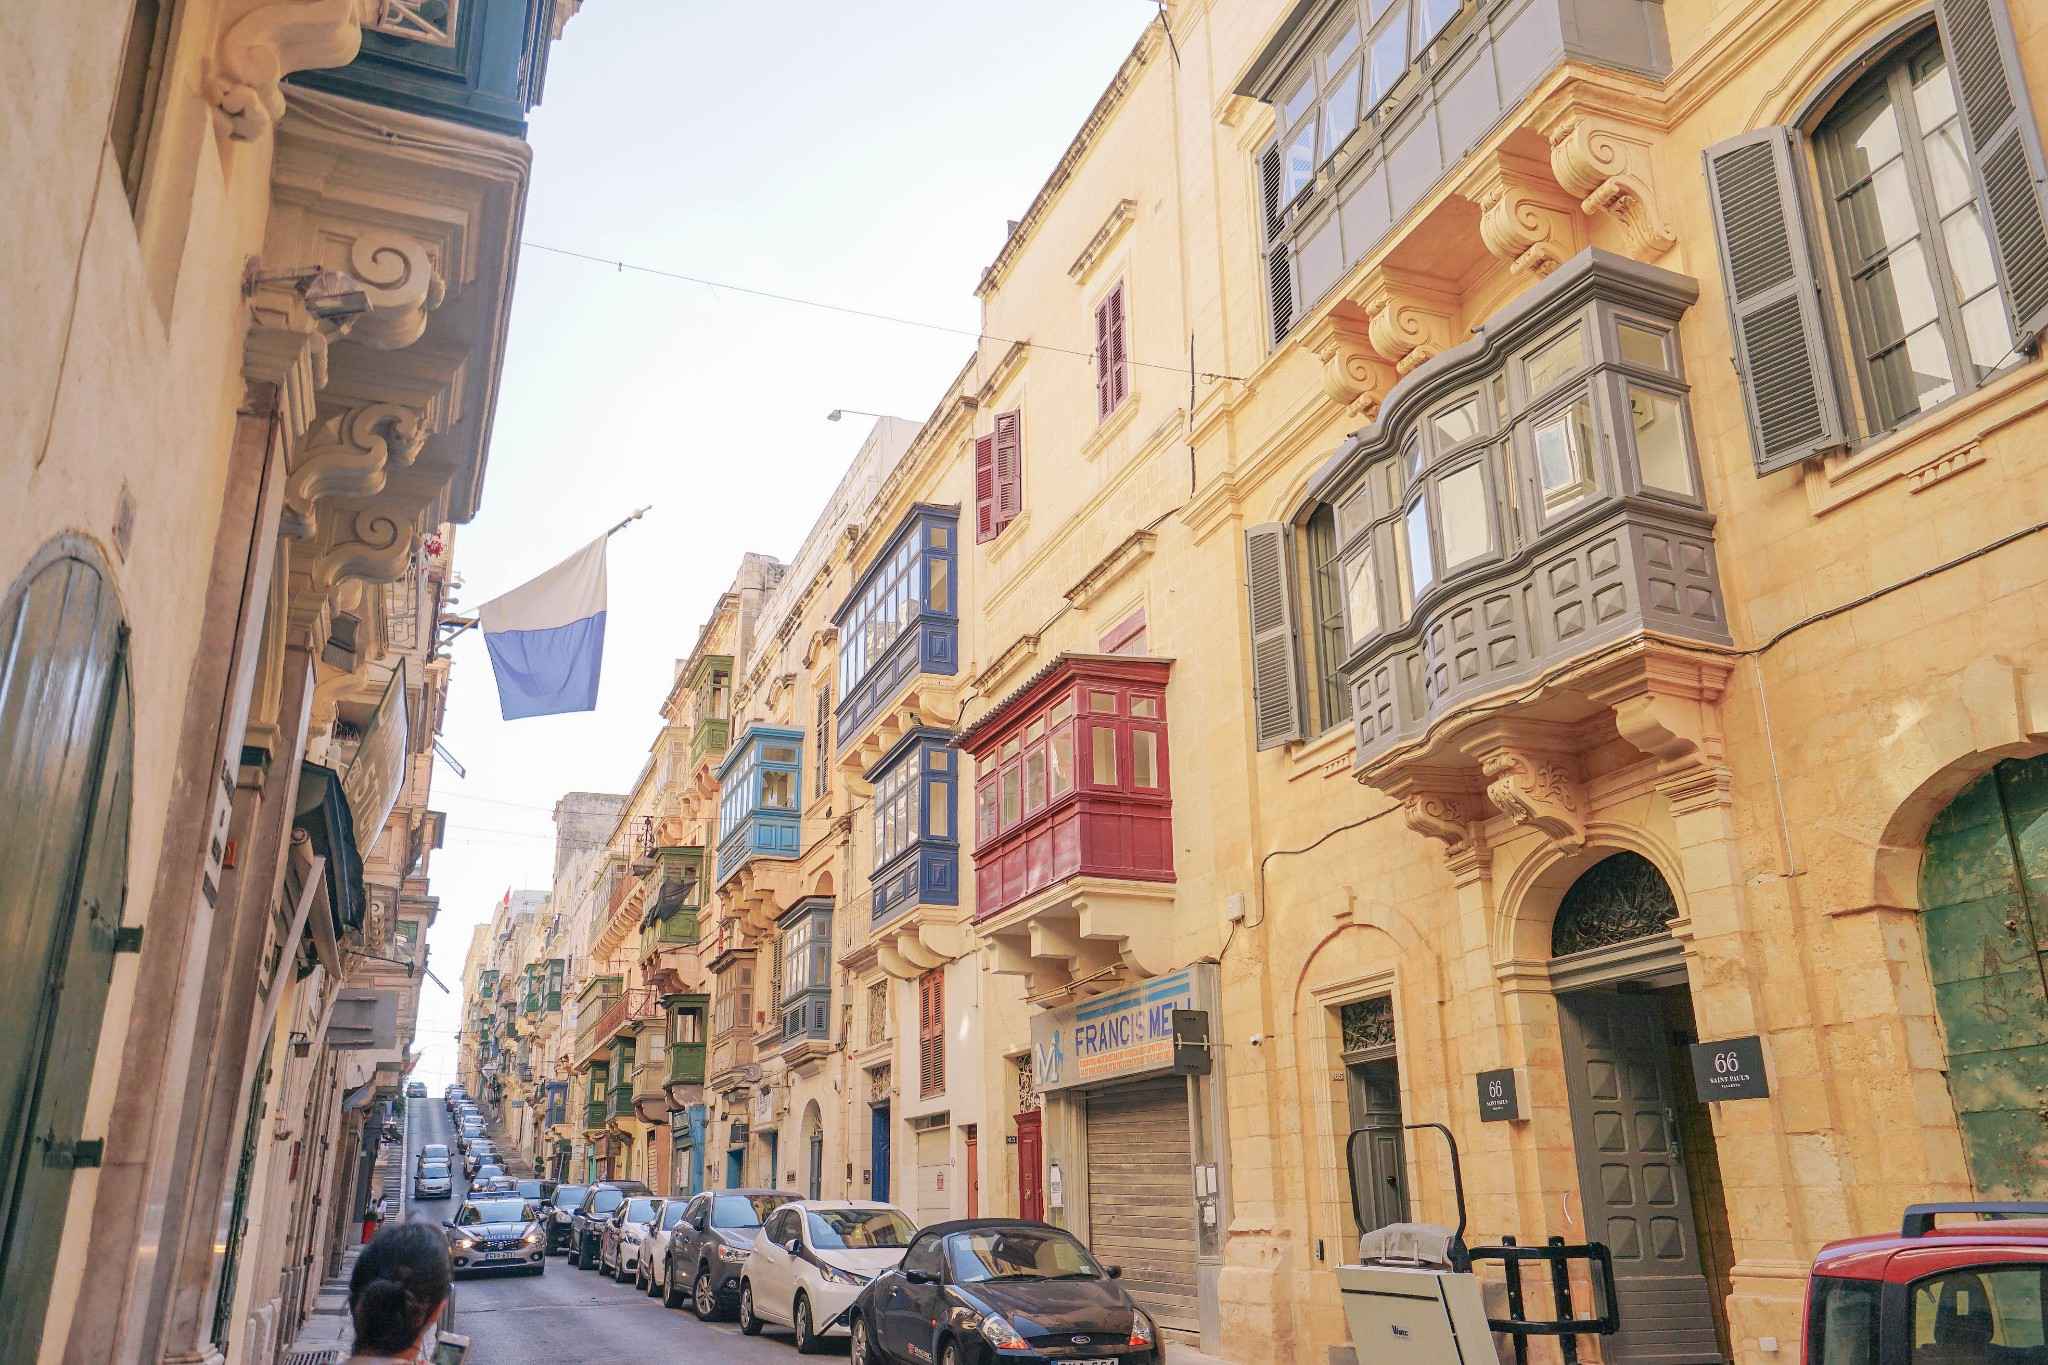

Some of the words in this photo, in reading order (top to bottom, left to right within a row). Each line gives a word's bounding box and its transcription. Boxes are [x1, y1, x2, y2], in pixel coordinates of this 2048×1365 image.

[1075, 1014, 1144, 1057] FRANCIS
[1150, 997, 1190, 1041] ME
[1714, 1051, 1739, 1073] 66
[1488, 1080, 1503, 1098] 66
[1710, 1076, 1728, 1084] SAINT
